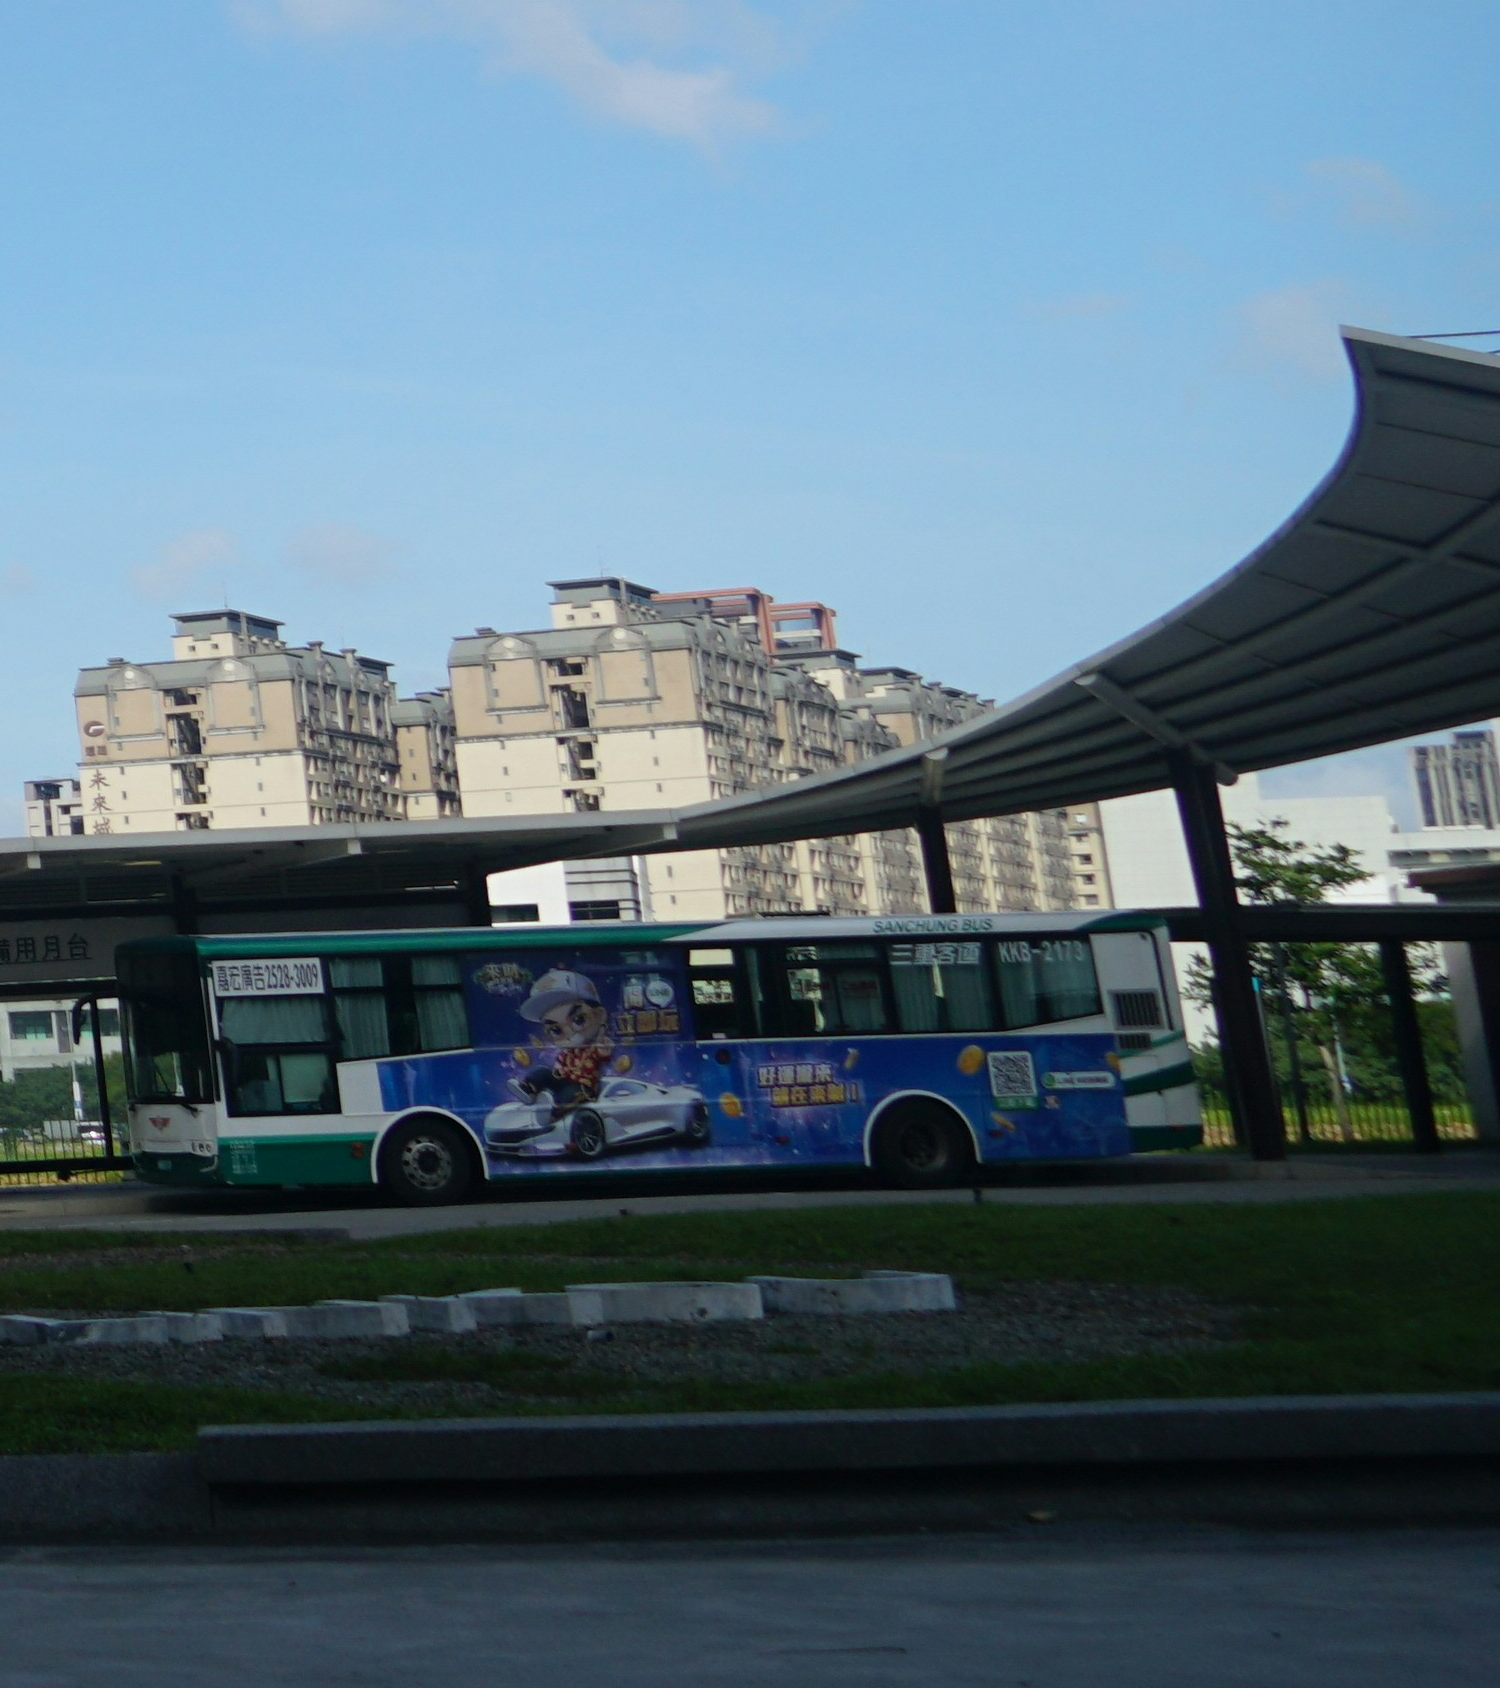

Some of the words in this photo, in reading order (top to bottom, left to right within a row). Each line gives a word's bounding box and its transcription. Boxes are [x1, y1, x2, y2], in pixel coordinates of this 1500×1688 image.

[873, 920, 958, 933] SANCHUNG
[962, 918, 994, 931] BUS
[998, 940, 1083, 963] KKB-2173
